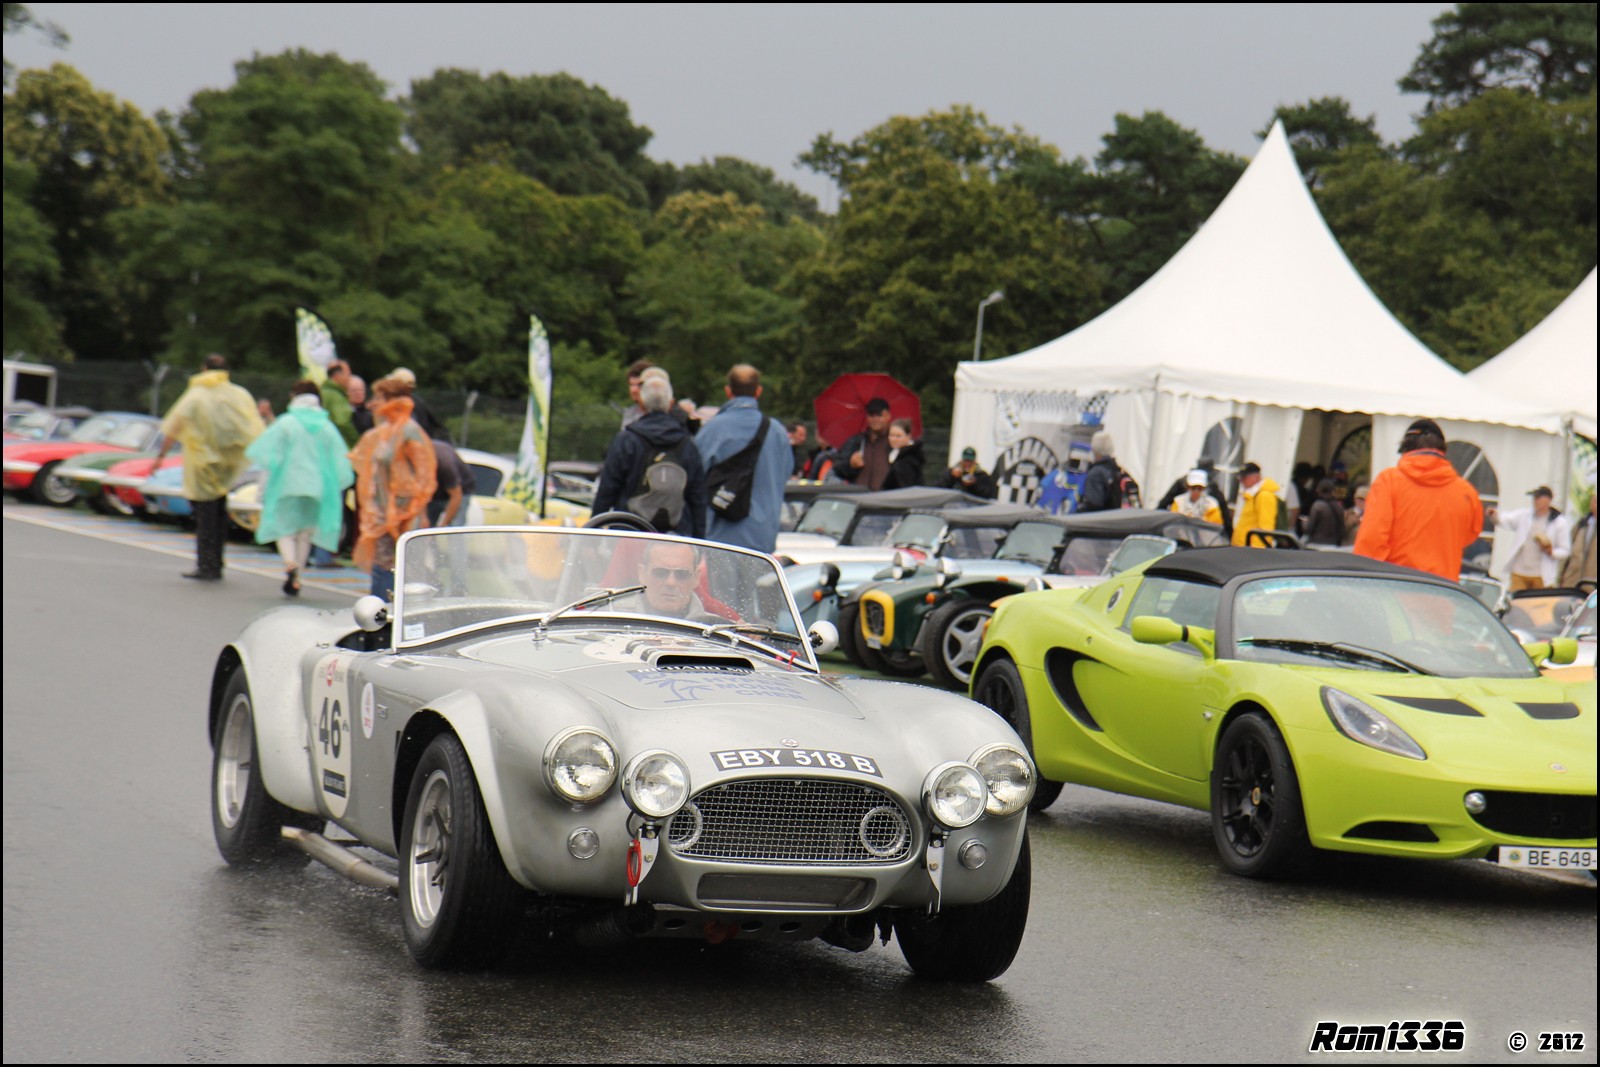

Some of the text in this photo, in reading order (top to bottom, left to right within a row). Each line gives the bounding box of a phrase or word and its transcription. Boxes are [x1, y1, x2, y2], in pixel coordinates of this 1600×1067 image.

[319, 696, 342, 759] 46
[716, 749, 876, 774] EBY 518 B
